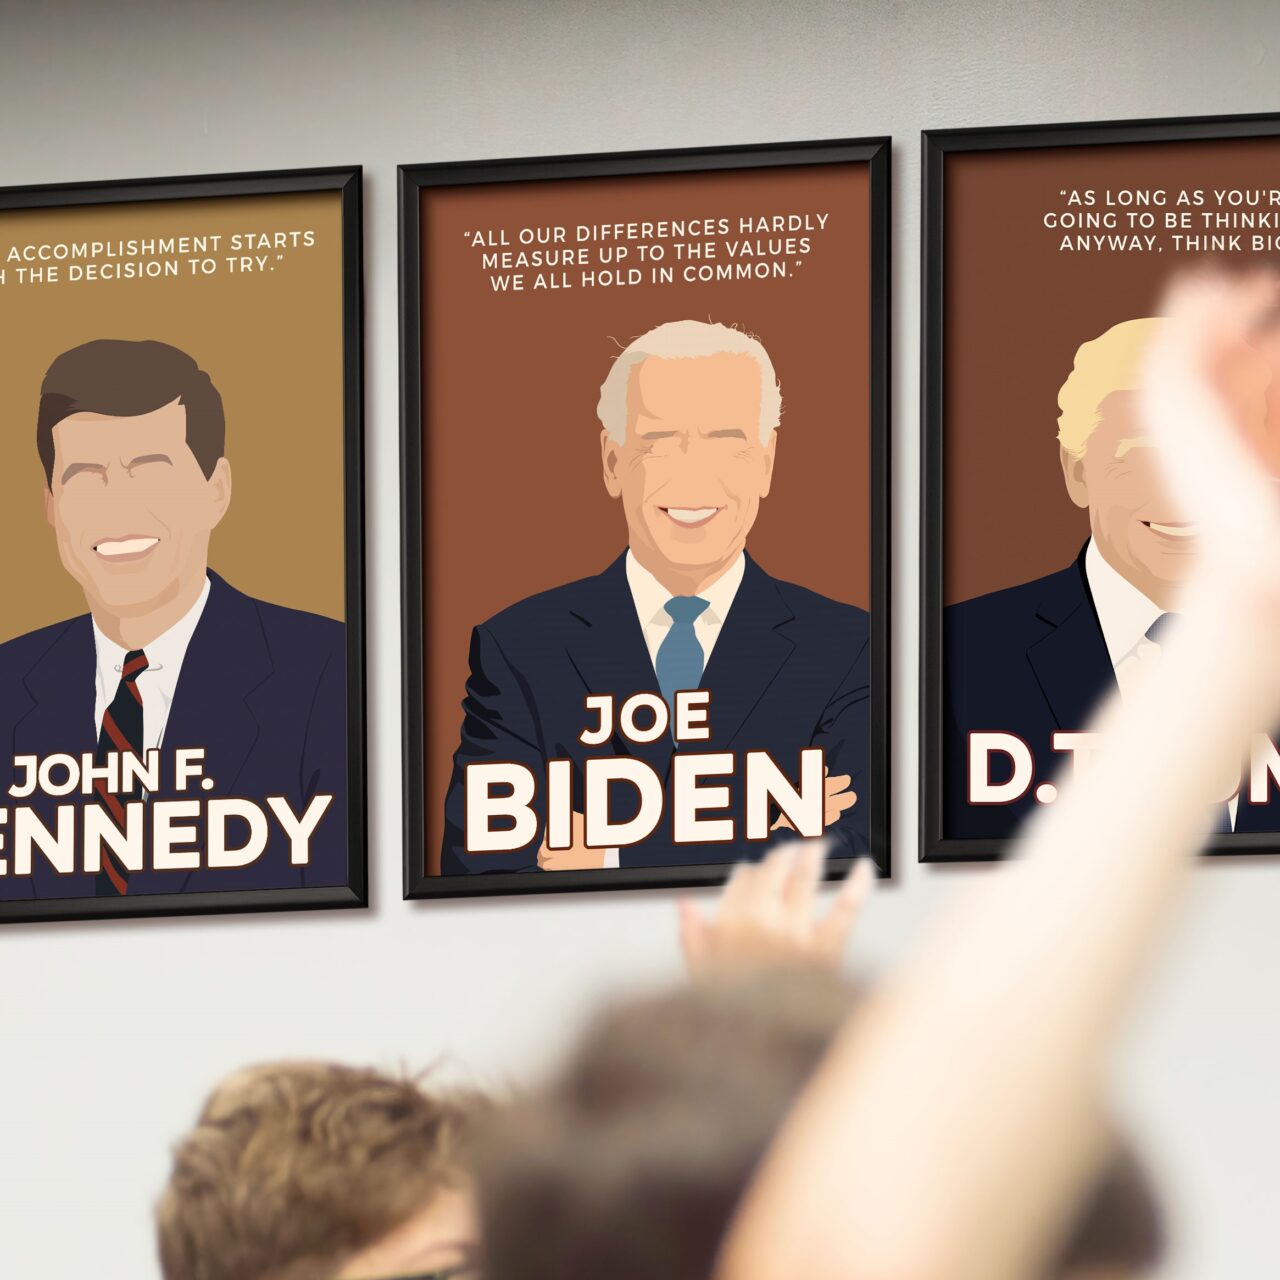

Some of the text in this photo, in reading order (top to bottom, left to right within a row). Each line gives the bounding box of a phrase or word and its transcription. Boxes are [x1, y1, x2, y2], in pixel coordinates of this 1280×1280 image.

[1107, 190, 1165, 205] LONG
[1177, 190, 1203, 205] AS
[520, 227, 565, 244] OUR
[577, 219, 728, 241] DIFFERENCES
[740, 214, 828, 233] HARDLY
[1044, 213, 1116, 228] GOING
[1127, 213, 1154, 228] TO
[1166, 213, 1191, 228] BE
[7, 231, 314, 261] ACCOMPLISHMENT STARTS
[483, 238, 810, 269] MEASURE UP TO THE VALUES
[1060, 236, 1161, 252] ANYWAY,
[1172, 236, 1241, 250] THINK
[16, 267, 58, 283] THE
[70, 261, 177, 280] DECISION
[188, 259, 216, 274] TO
[491, 275, 523, 291] WE
[534, 273, 571, 289] ALL
[583, 269, 641, 287] HOLD
[653, 268, 672, 283] IN
[579, 691, 710, 745] JOE
[8, 749, 214, 797] JOHN F.
[466, 749, 823, 851] BIDEN
[0, 795, 333, 875] NNEDY
